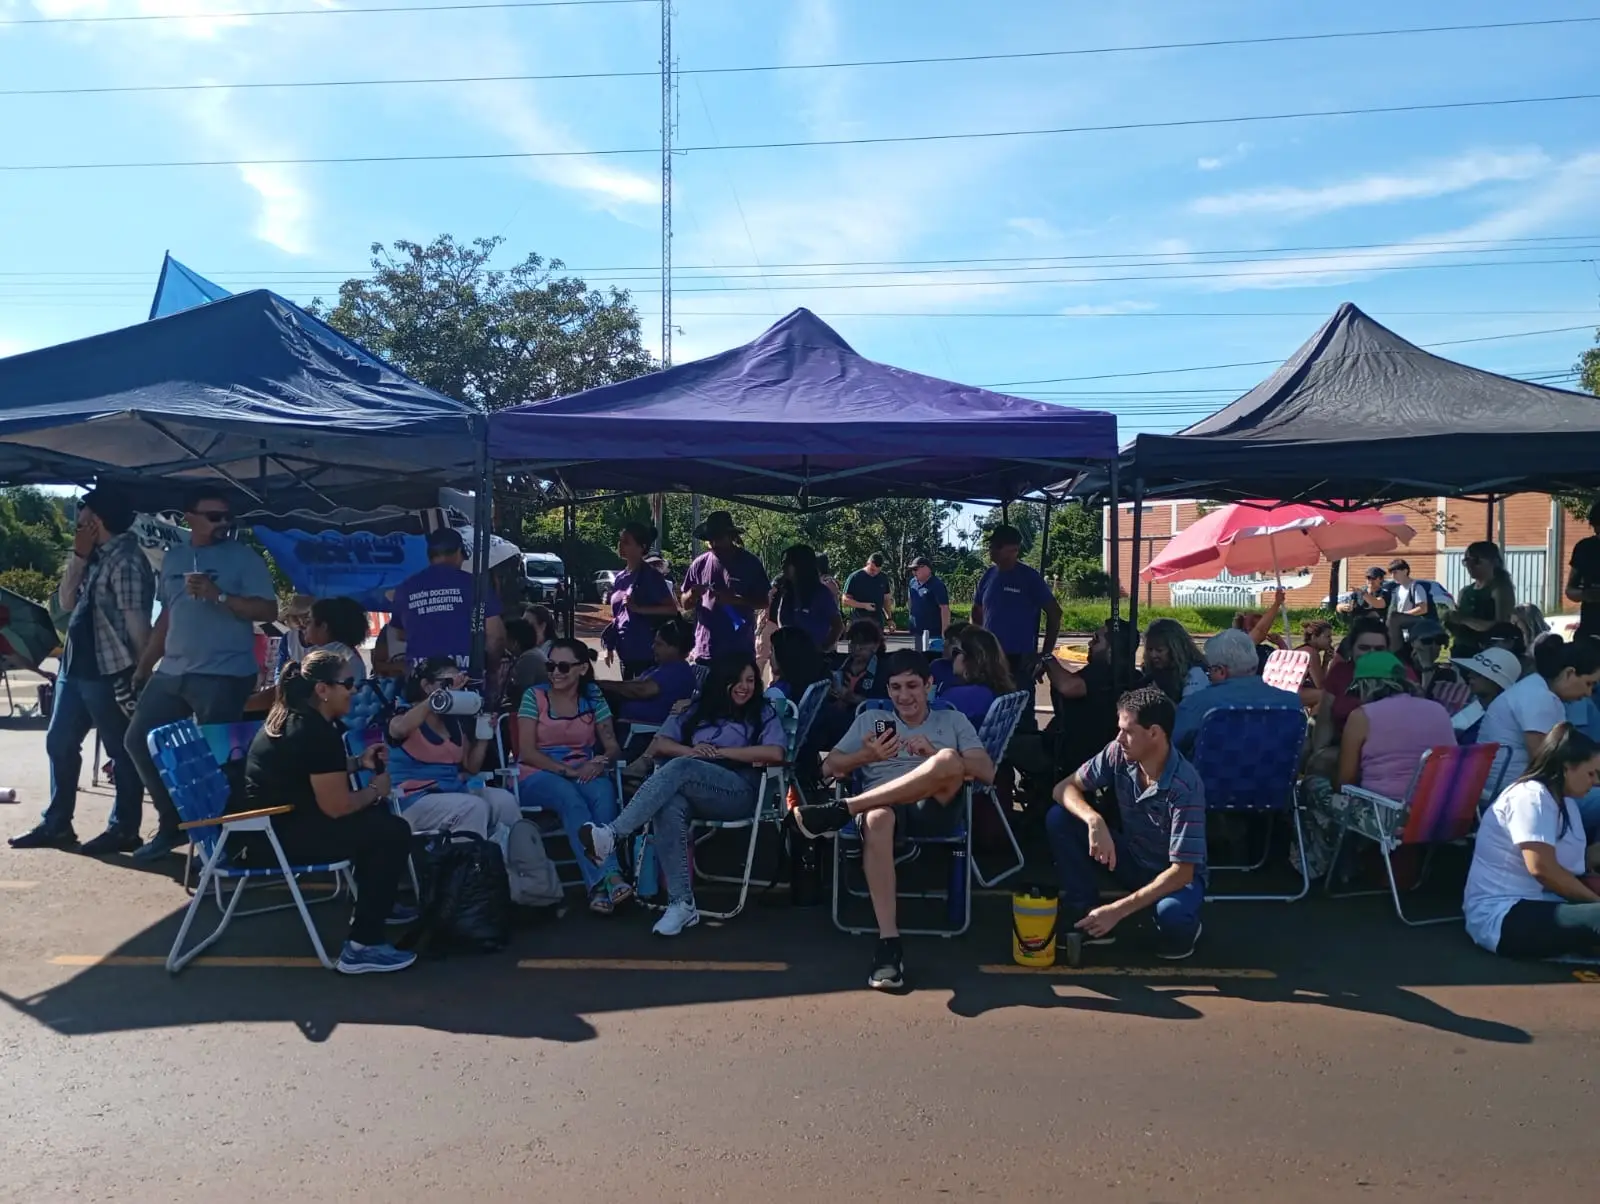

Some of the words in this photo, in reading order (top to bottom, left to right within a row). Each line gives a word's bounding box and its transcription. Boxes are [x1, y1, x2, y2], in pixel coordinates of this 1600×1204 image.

[430, 588, 461, 597] DOCENTES
[408, 598, 428, 609] NUEVA
[428, 595, 463, 605] ARGENTINA
[426, 603, 454, 613] MISIONES
